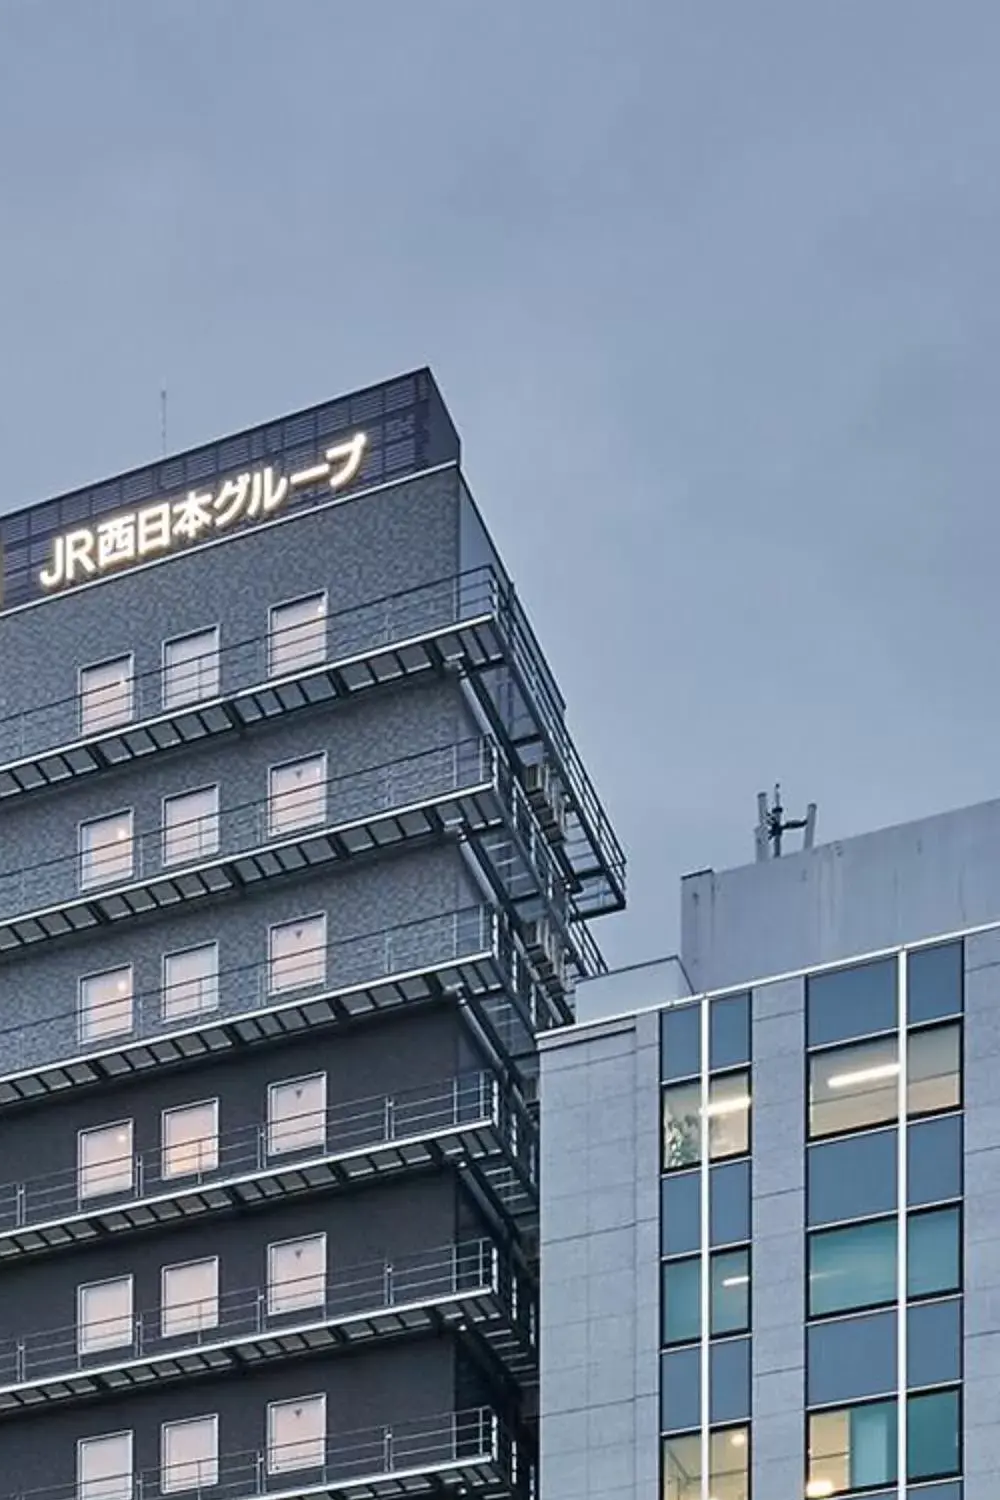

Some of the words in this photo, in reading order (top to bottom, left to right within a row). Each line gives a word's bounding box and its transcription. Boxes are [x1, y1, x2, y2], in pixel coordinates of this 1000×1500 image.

[39, 432, 367, 587] JR西日本グループ
